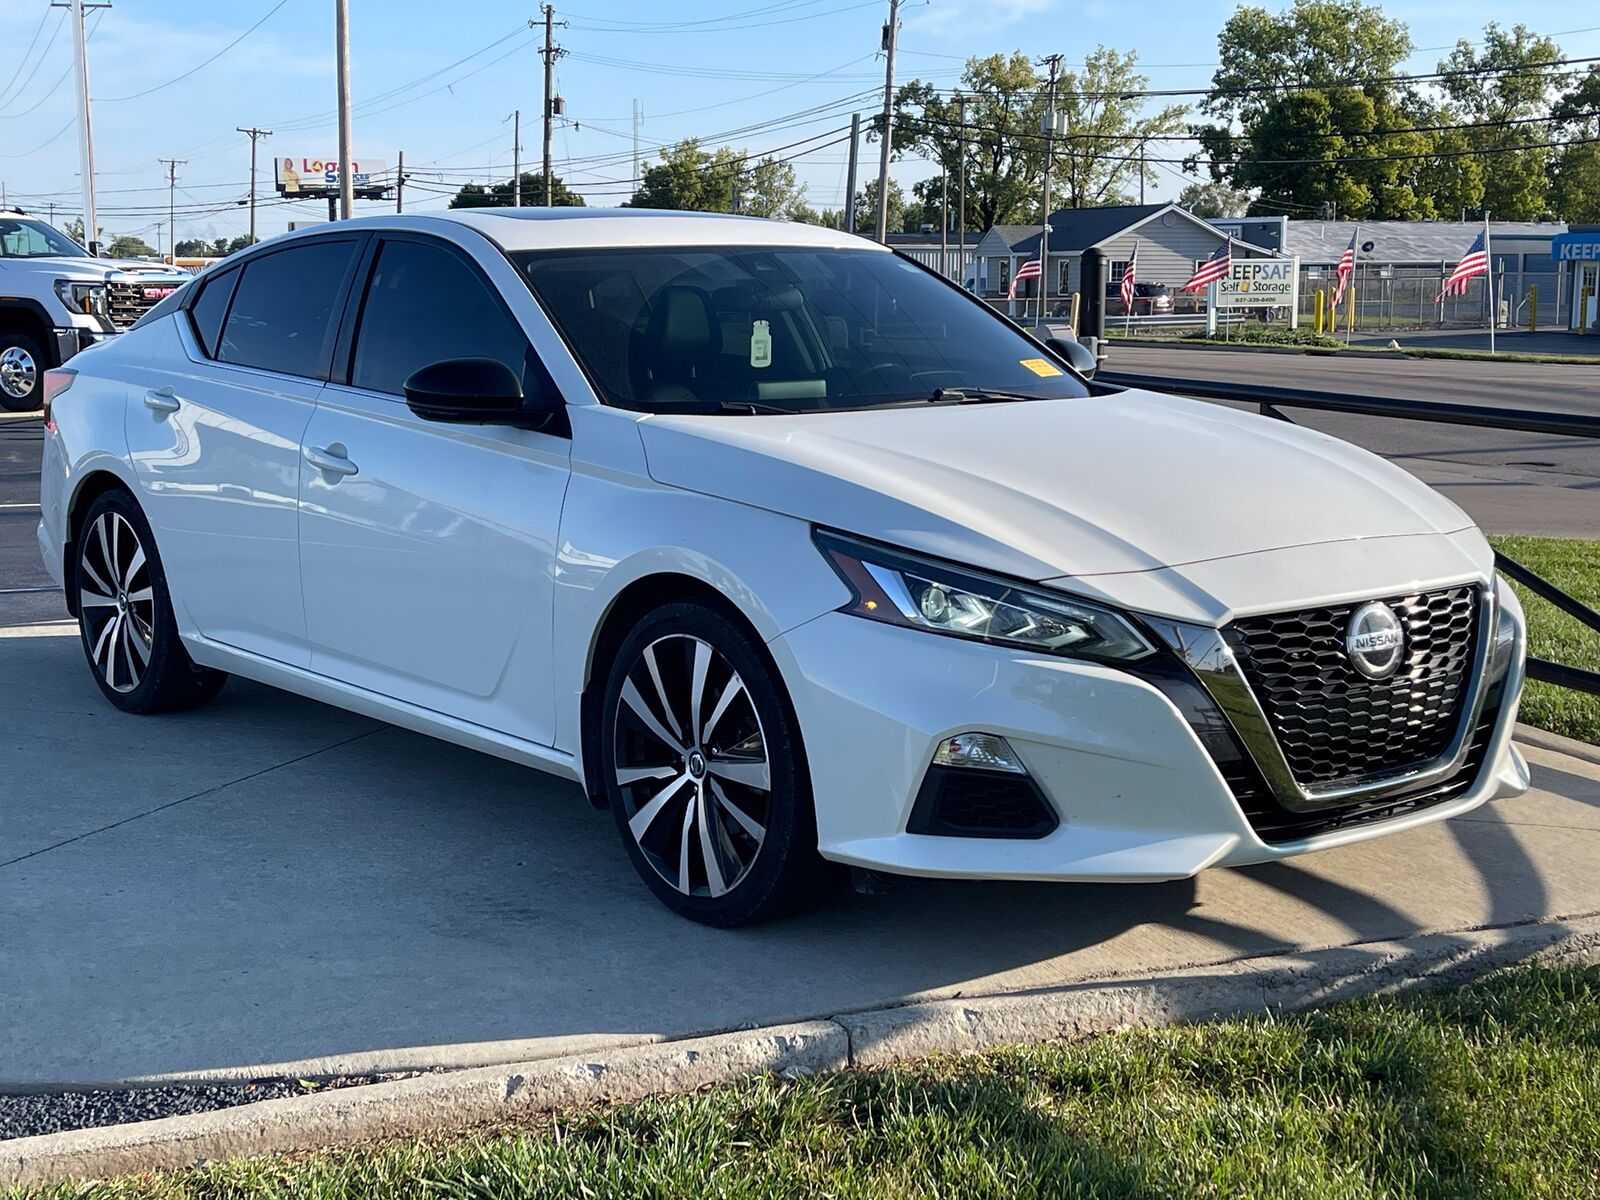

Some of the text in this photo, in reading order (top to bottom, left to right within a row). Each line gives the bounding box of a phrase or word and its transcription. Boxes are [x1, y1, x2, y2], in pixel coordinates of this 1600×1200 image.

[303, 159, 358, 174] Logn
[1560, 243, 1600, 259] KEEP
[1221, 264, 1291, 280] EEPSAF
[1221, 281, 1291, 294] Self Storage
[1356, 633, 1398, 649] NISSAN
